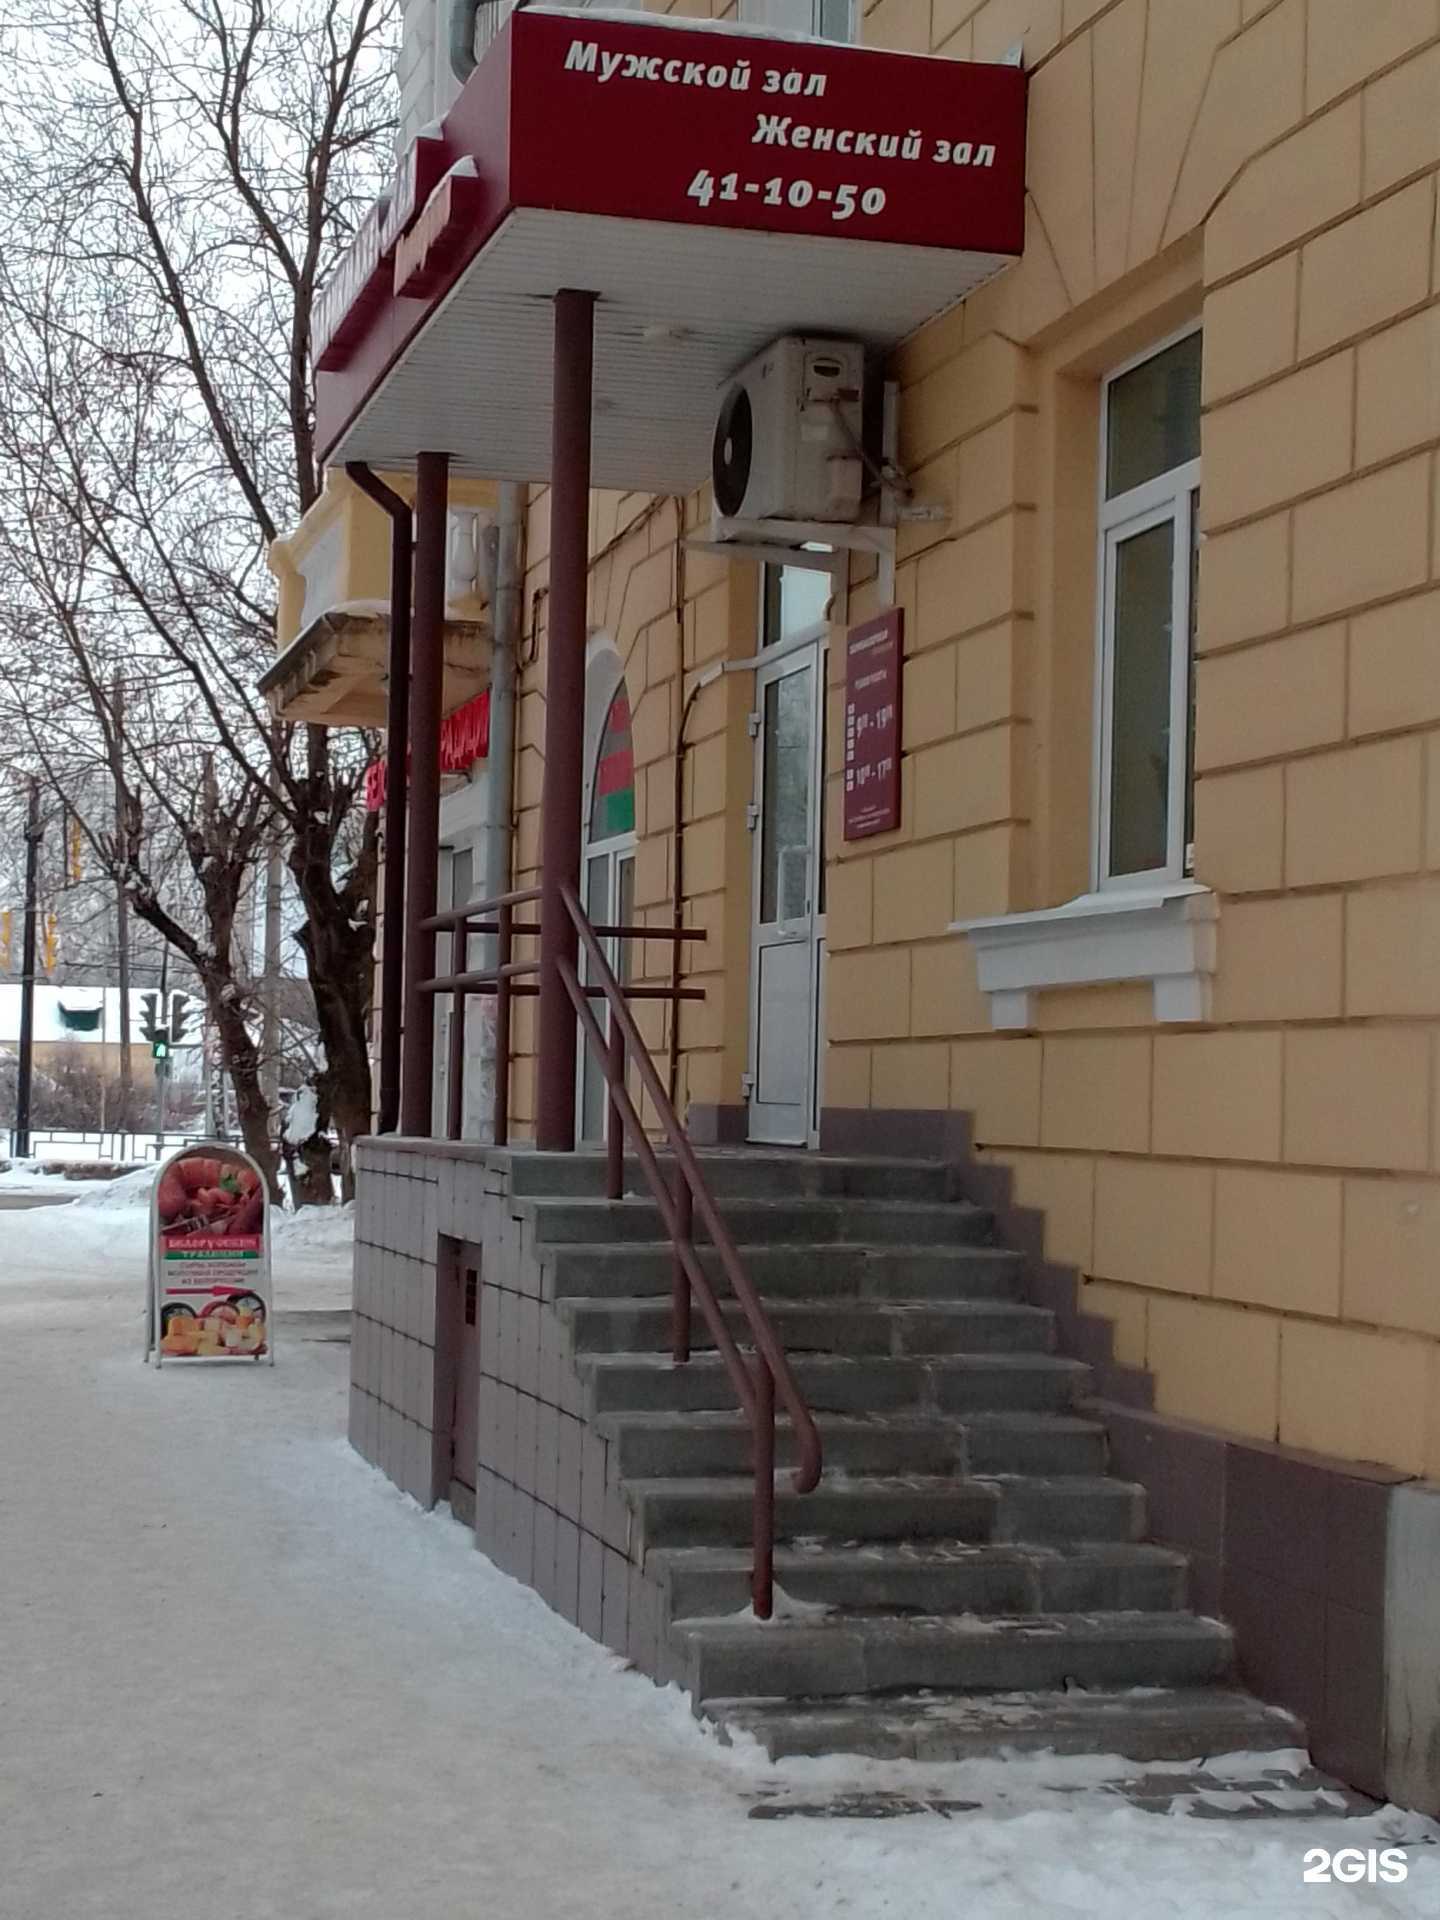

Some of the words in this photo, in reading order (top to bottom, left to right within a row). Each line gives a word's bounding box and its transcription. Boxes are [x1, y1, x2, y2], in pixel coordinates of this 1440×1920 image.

[564, 40, 751, 91] Мужской
[761, 69, 827, 97] зал
[752, 113, 922, 160] Женский
[932, 139, 996, 167] зал
[687, 169, 886, 220] 41-10-50
